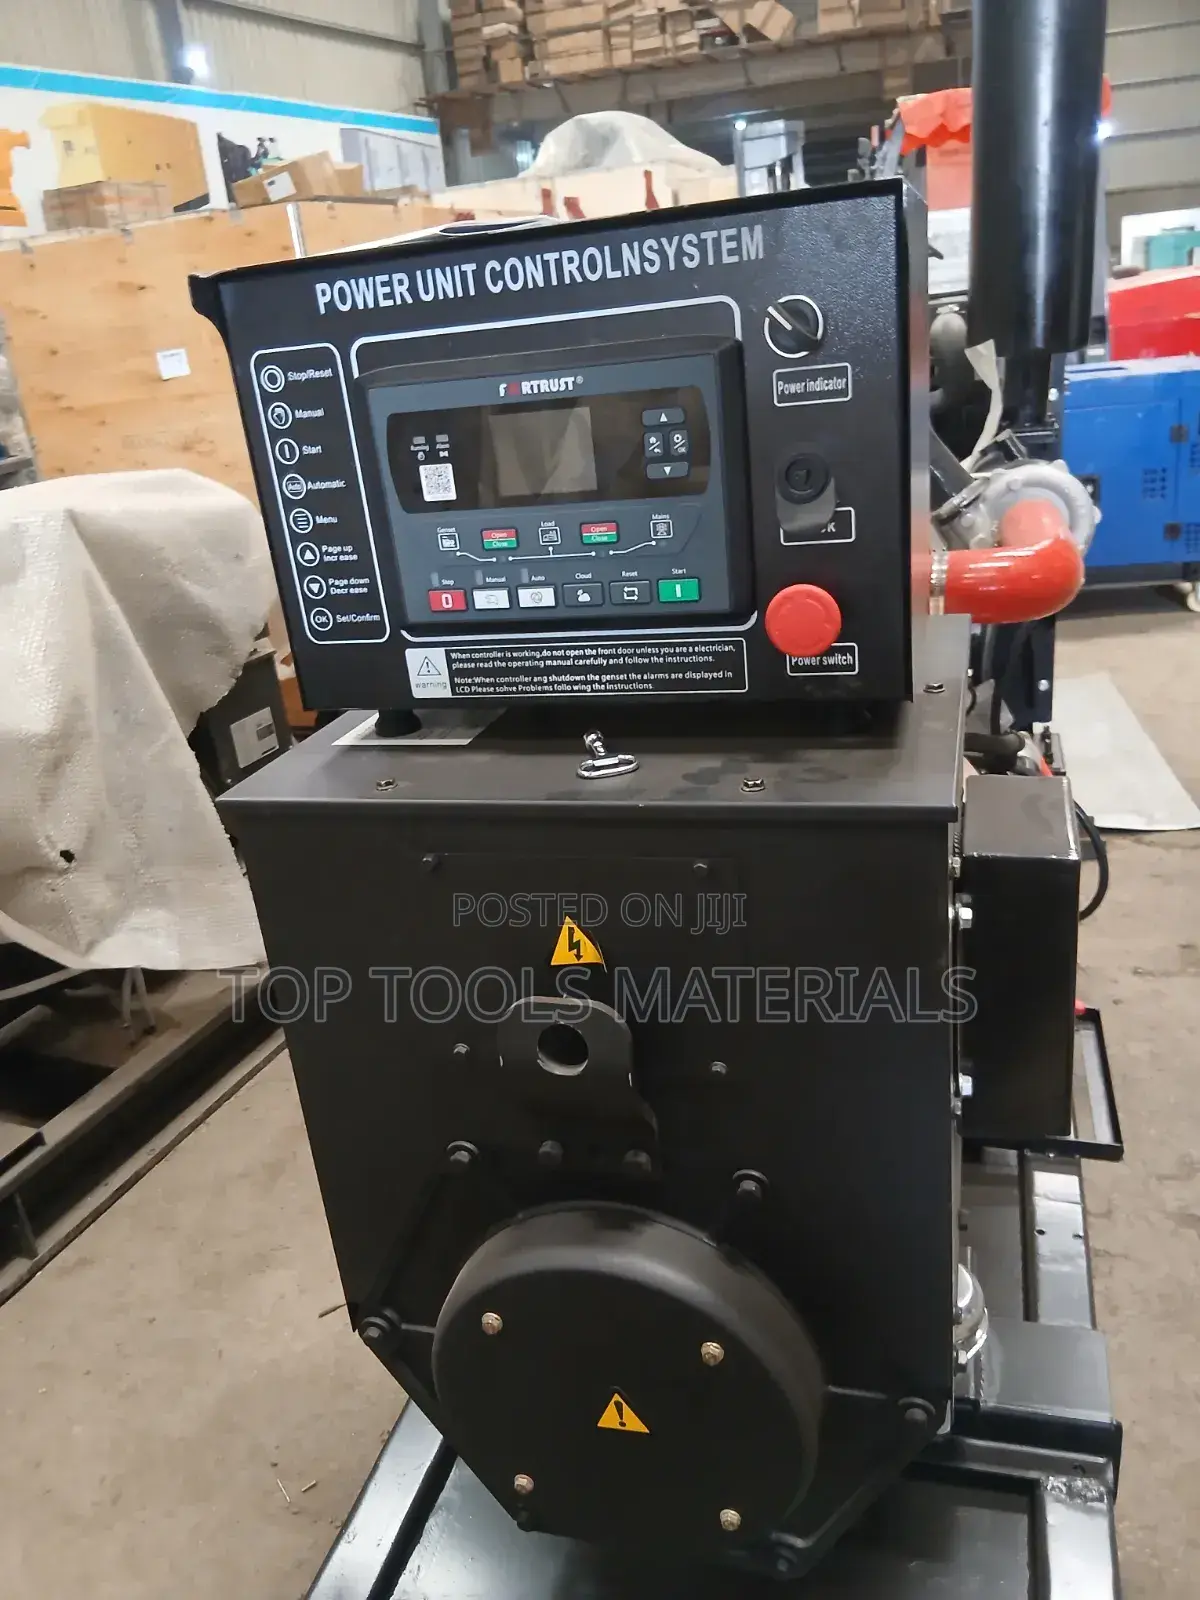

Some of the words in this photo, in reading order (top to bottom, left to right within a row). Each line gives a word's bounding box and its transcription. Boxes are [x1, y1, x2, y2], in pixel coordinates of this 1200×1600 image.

[315, 272, 413, 314] POWER
[416, 262, 477, 302] UNIT
[484, 224, 764, 294] CONTROLNSYSTEM
[287, 368, 333, 382] Stop/Reset
[777, 380, 806, 395] Power
[806, 376, 847, 393] indicator
[295, 408, 324, 419] Manual
[302, 445, 322, 455] Start
[307, 479, 347, 490] Automatic
[315, 515, 338, 524] Menu
[322, 545, 341, 554] Page
[324, 554, 338, 562] Incr
[329, 578, 348, 587] Page
[350, 577, 370, 585] down
[330, 587, 348, 595] Decr
[315, 615, 328, 623] OK
[336, 613, 381, 623] Set/Confirm
[471, 651, 504, 659] controller
[598, 647, 616, 655] front
[636, 646, 659, 654] unless
[660, 647, 674, 655] you
[452, 661, 475, 670] please
[476, 660, 492, 668] read
[507, 659, 544, 668] operating
[545, 658, 573, 666] manual
[574, 657, 607, 666] carefully
[609, 656, 623, 664] and
[625, 656, 649, 664] follow
[651, 655, 663, 663] the
[665, 655, 715, 663] instructions.
[791, 656, 821, 666] Power
[822, 652, 853, 665] switch
[496, 675, 532, 683] controller
[587, 673, 599, 681] the
[601, 674, 627, 682] genset
[629, 672, 641, 680] the
[685, 670, 723, 680] displayed
[725, 670, 733, 678] in
[415, 682, 447, 690] warning
[456, 685, 470, 693] LCD
[518, 684, 553, 692] Problems
[554, 683, 572, 691] follo
[572, 683, 591, 692] wing
